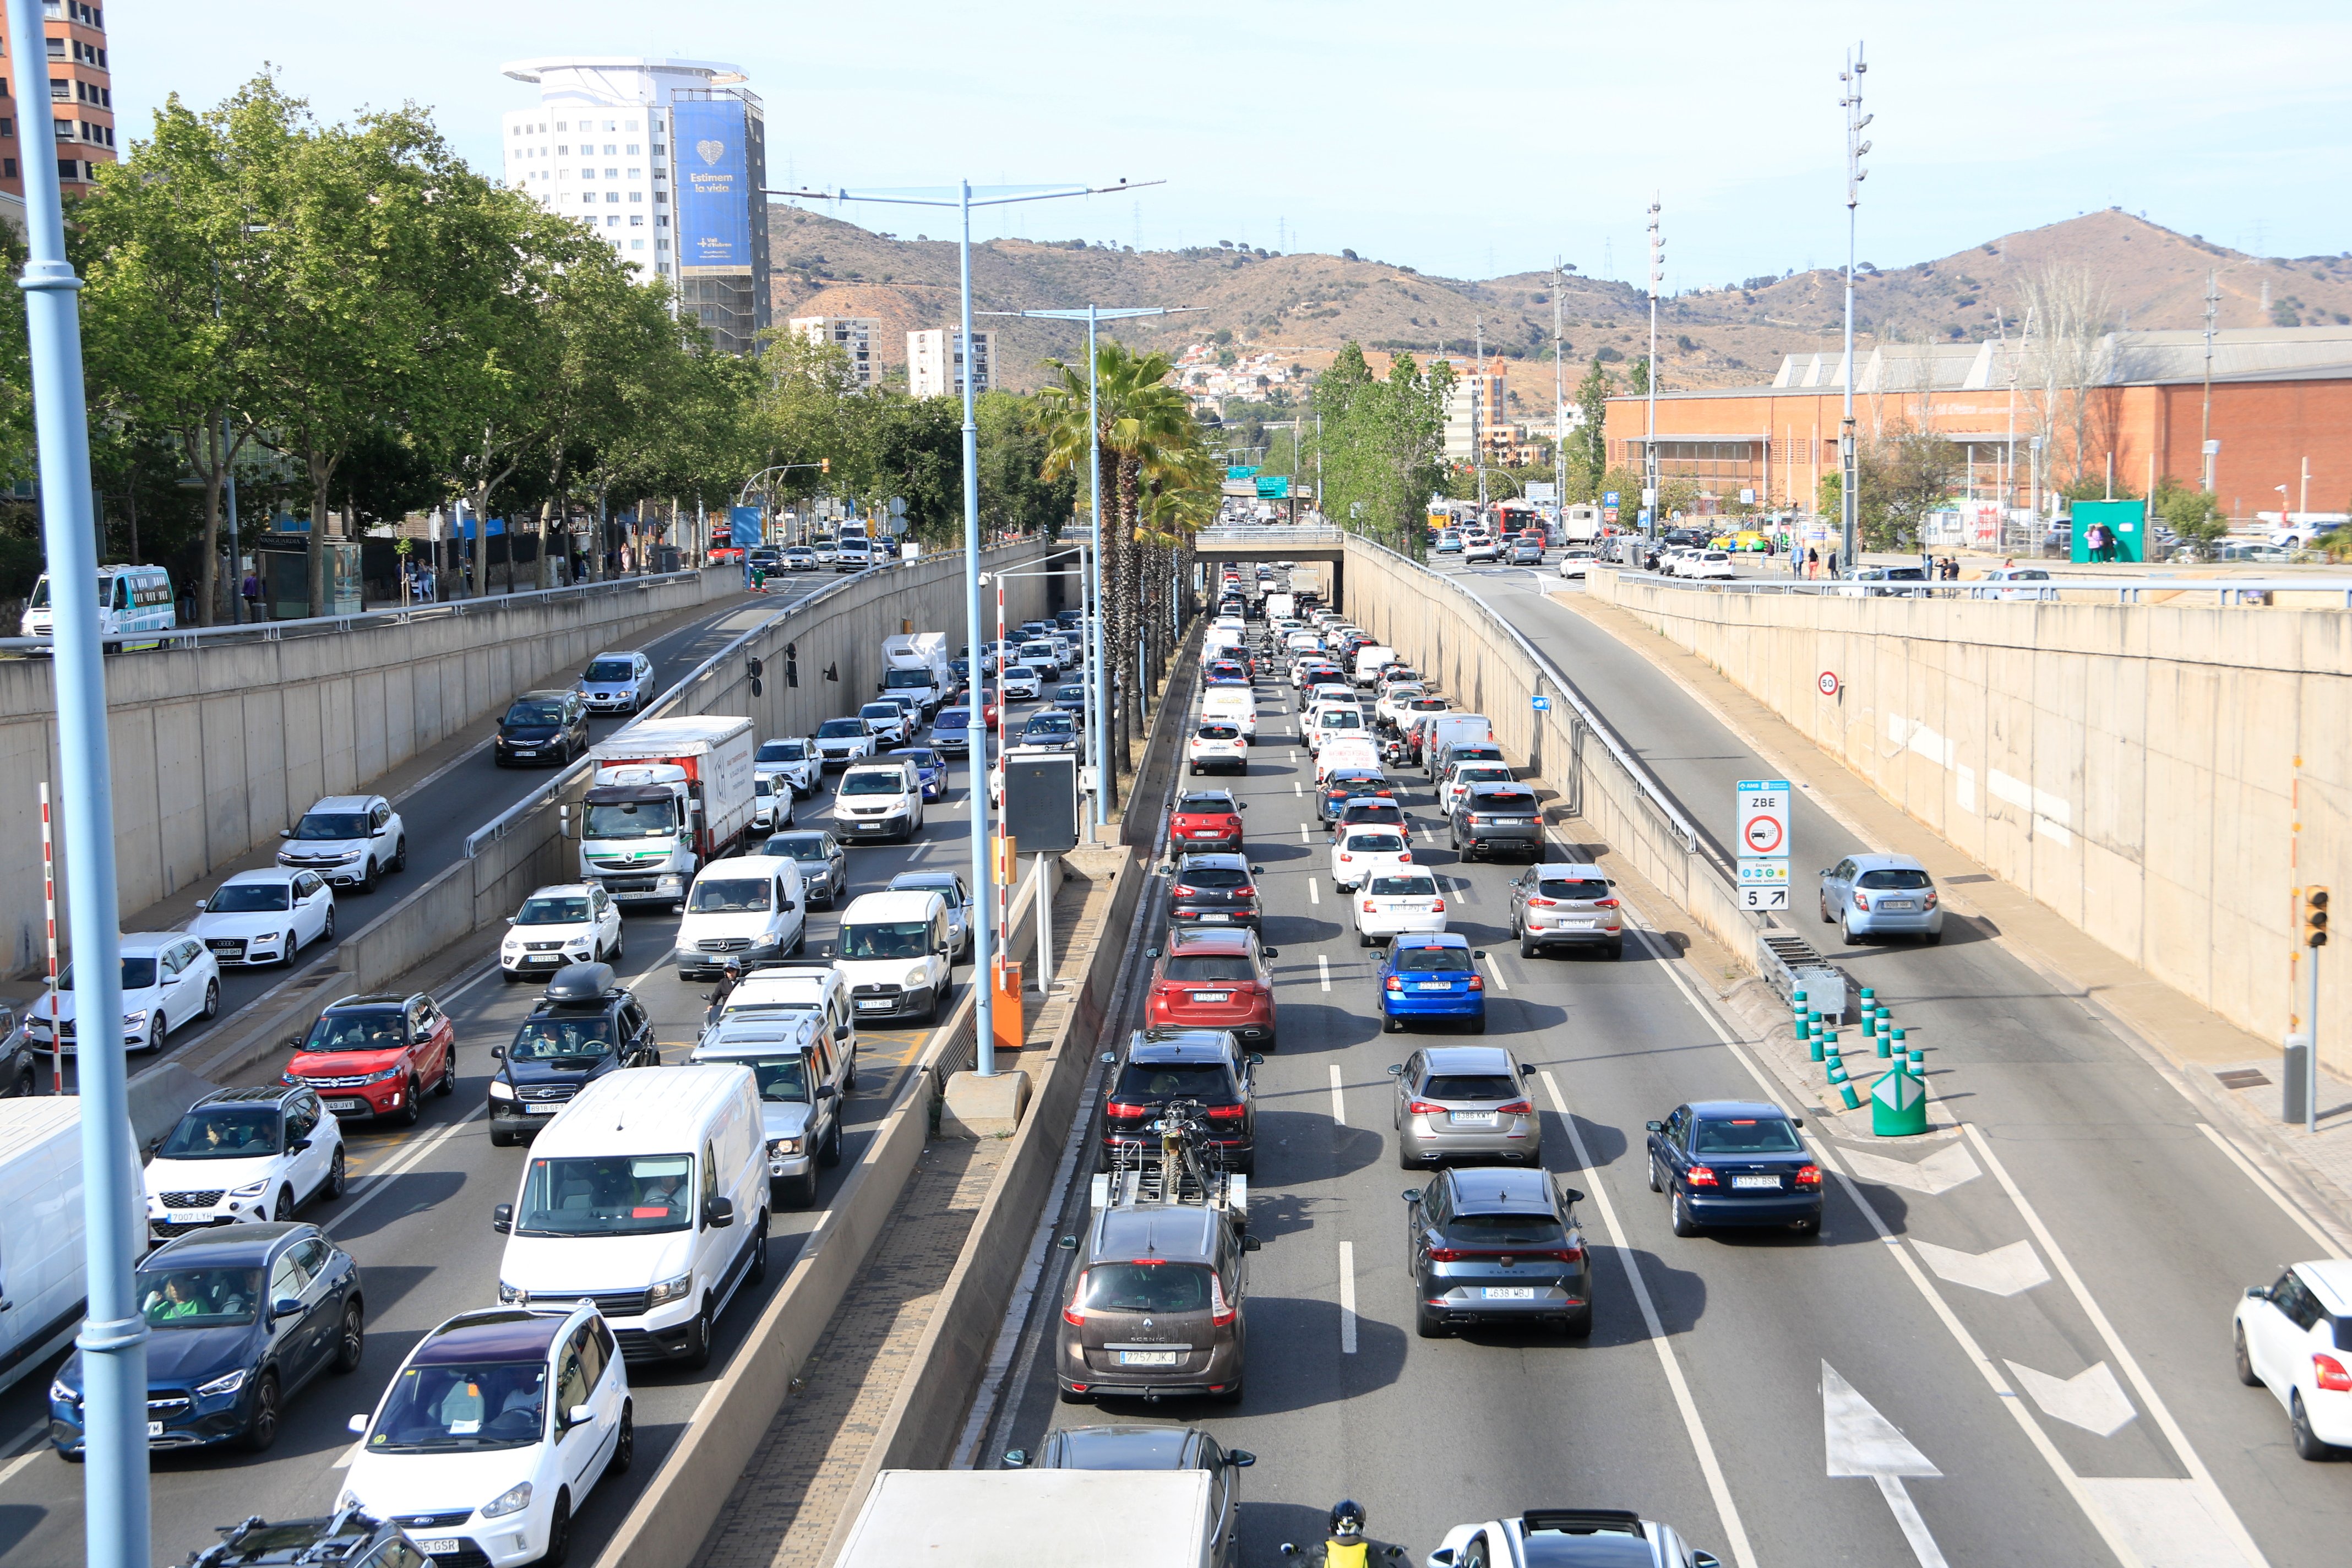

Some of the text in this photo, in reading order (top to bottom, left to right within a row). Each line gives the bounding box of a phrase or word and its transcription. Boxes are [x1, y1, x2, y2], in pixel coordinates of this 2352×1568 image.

[690, 173, 733, 182] Estimem
[695, 183, 729, 192] la vida
[1752, 798, 1775, 807] ZBE
[1747, 891, 1757, 906] 5
[1488, 1288, 1529, 1297] 4638 MBJ
[1127, 1353, 1173, 1362] 7757 JKJ
[434, 1540, 455, 1551] GSR
